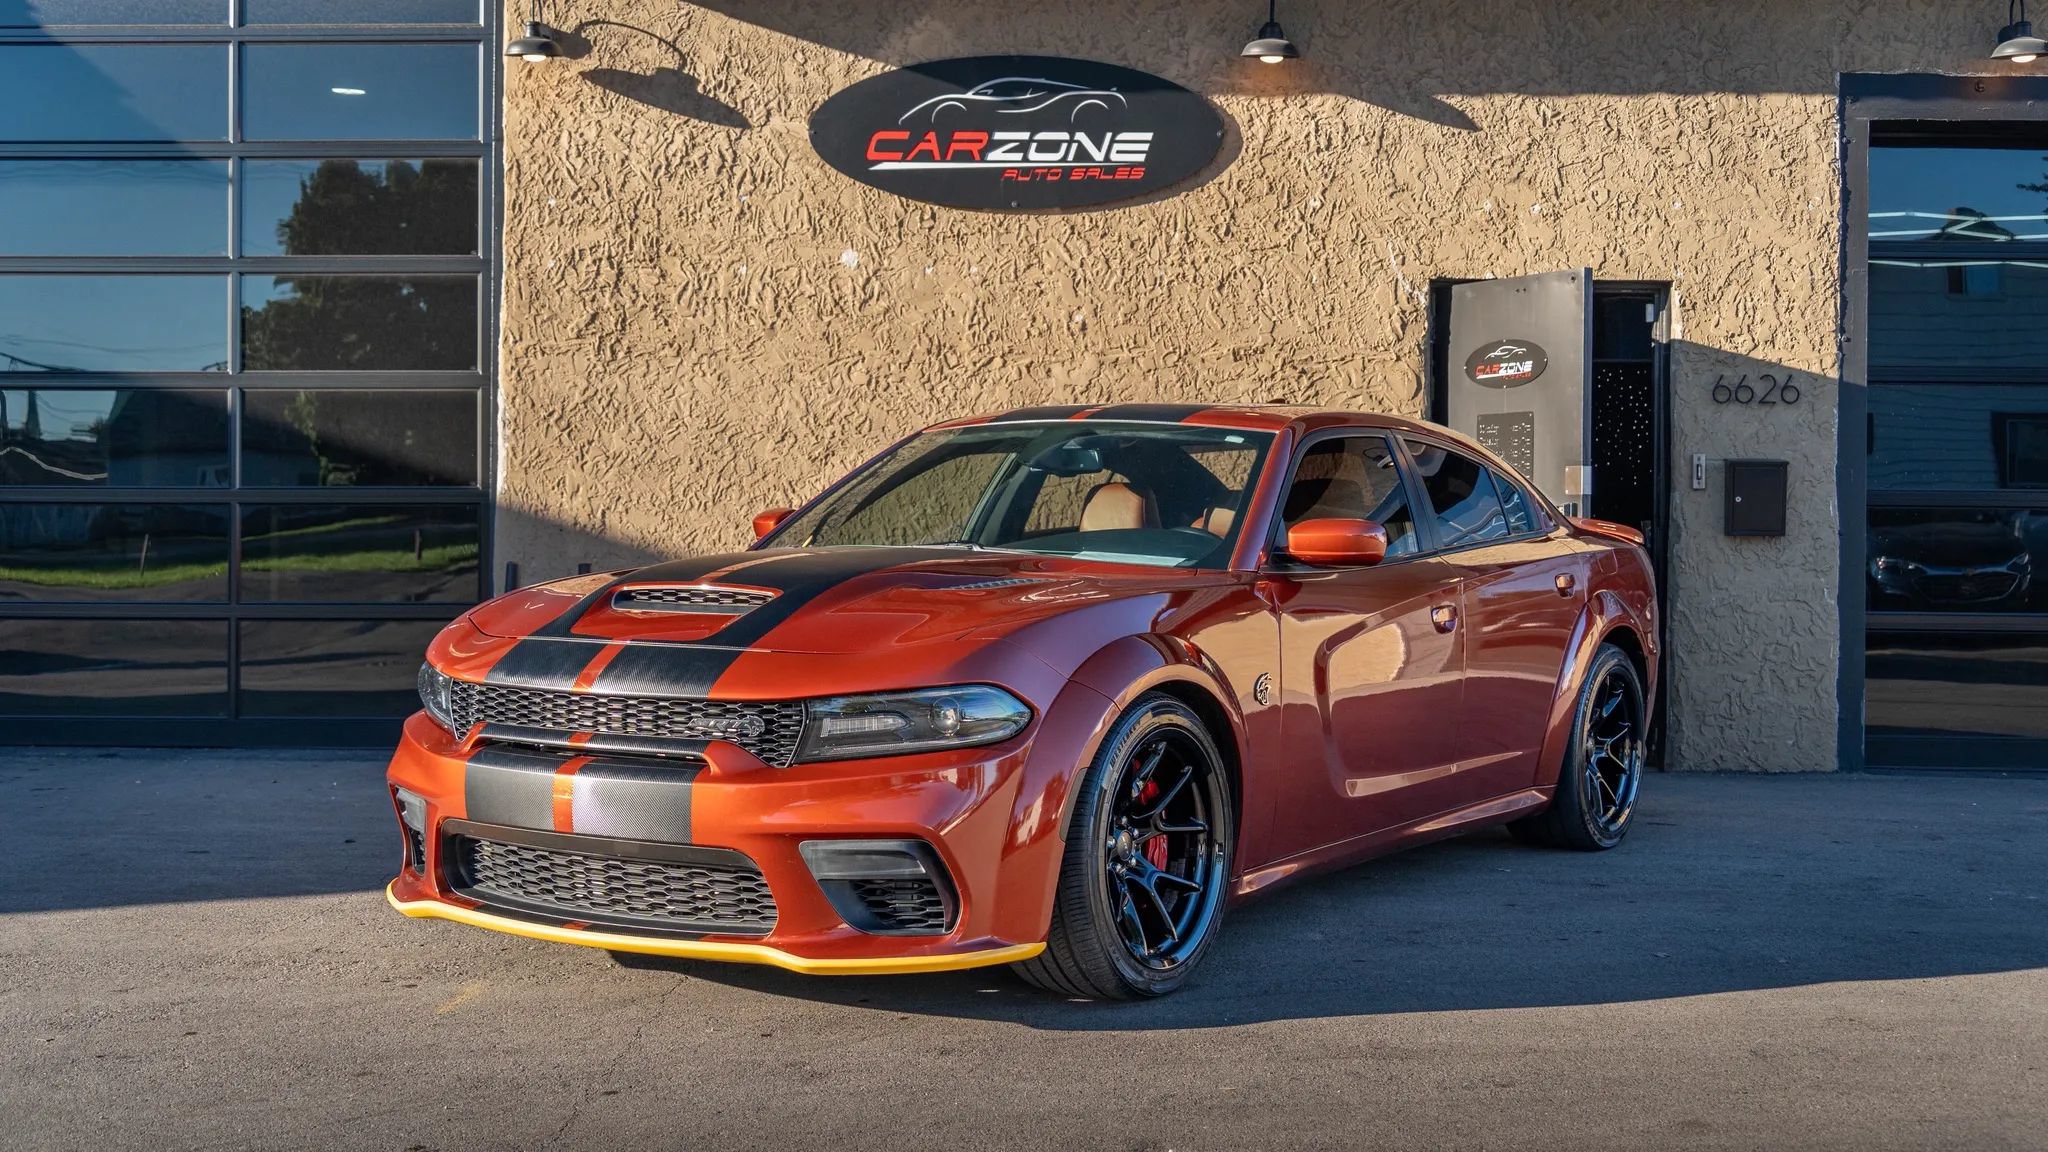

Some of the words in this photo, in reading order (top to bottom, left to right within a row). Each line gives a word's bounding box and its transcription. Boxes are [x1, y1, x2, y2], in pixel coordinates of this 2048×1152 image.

[866, 131, 1154, 162] CARZONE
[1001, 168, 1062, 181] AUTO
[1069, 167, 1145, 180] SALES
[1475, 360, 1533, 376] CARZONE
[1712, 374, 1800, 404] 6626
